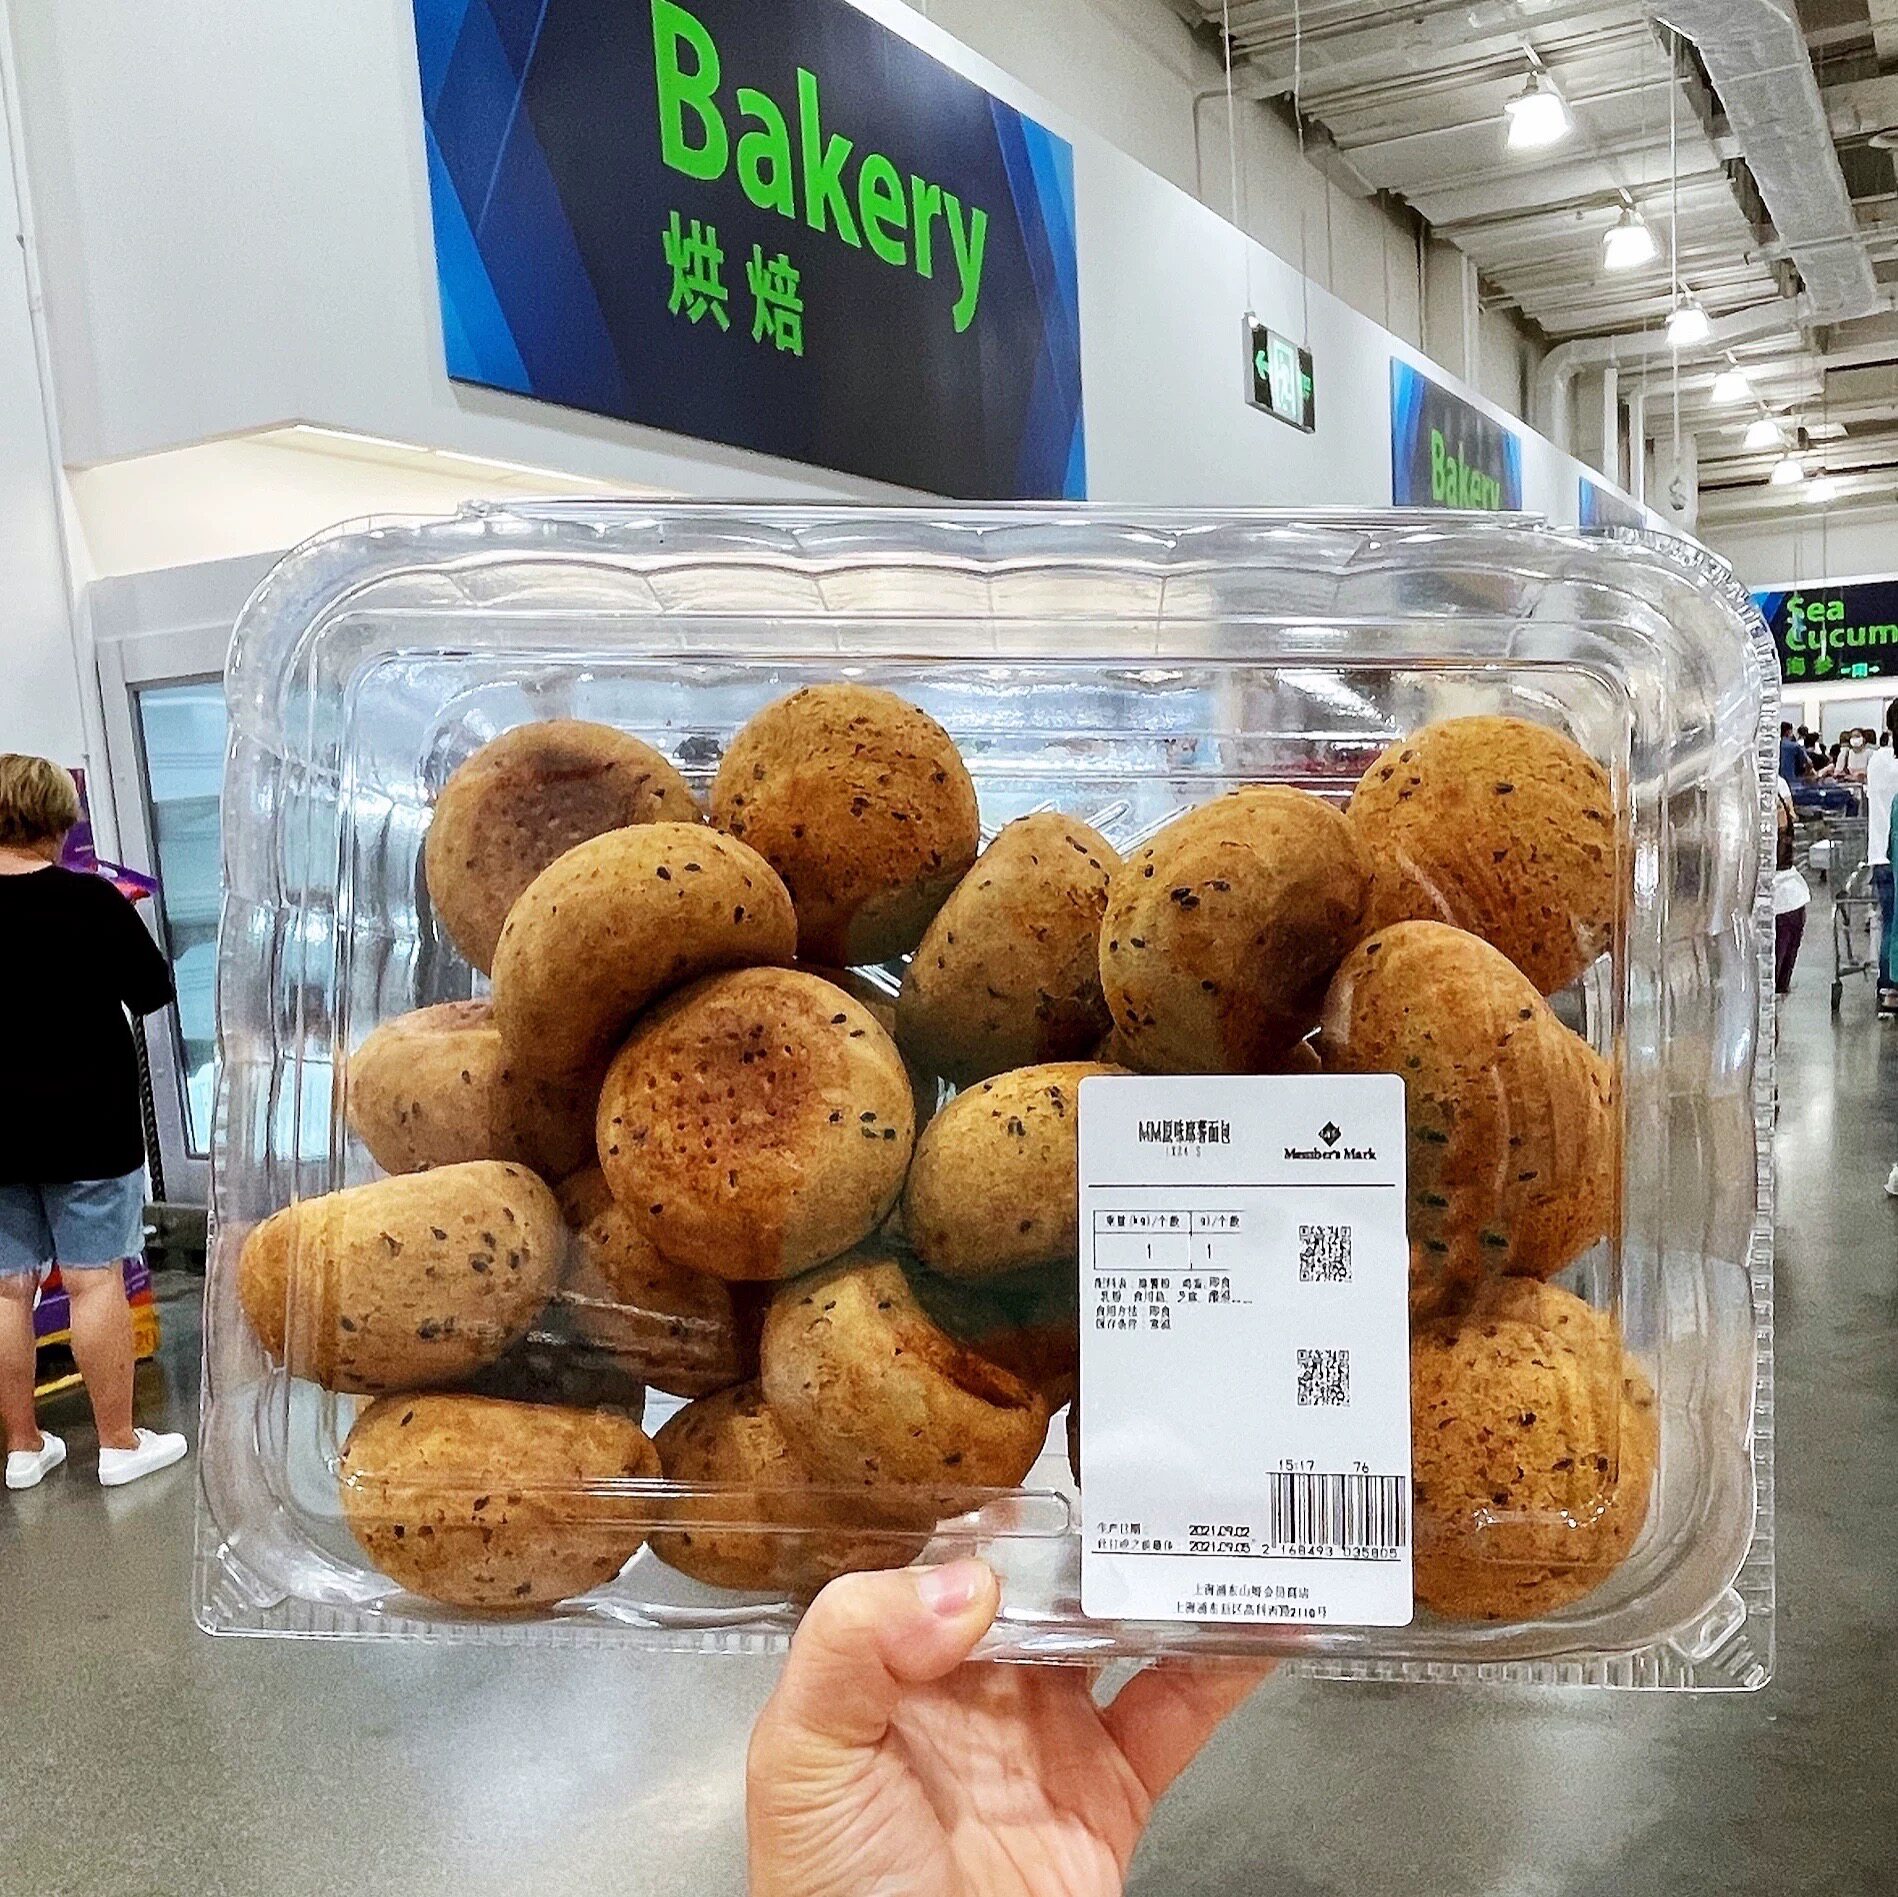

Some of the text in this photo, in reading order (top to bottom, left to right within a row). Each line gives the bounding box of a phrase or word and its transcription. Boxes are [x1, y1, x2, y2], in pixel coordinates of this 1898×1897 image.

[651, 0, 988, 333] Bakery
[662, 210, 804, 356] 烘焙
[1431, 428, 1500, 510] Bakery
[1786, 594, 1845, 623] Sea
[1343, 1147, 1377, 1161] Mark
[1188, 1524, 1250, 1538] 2021.09.02
